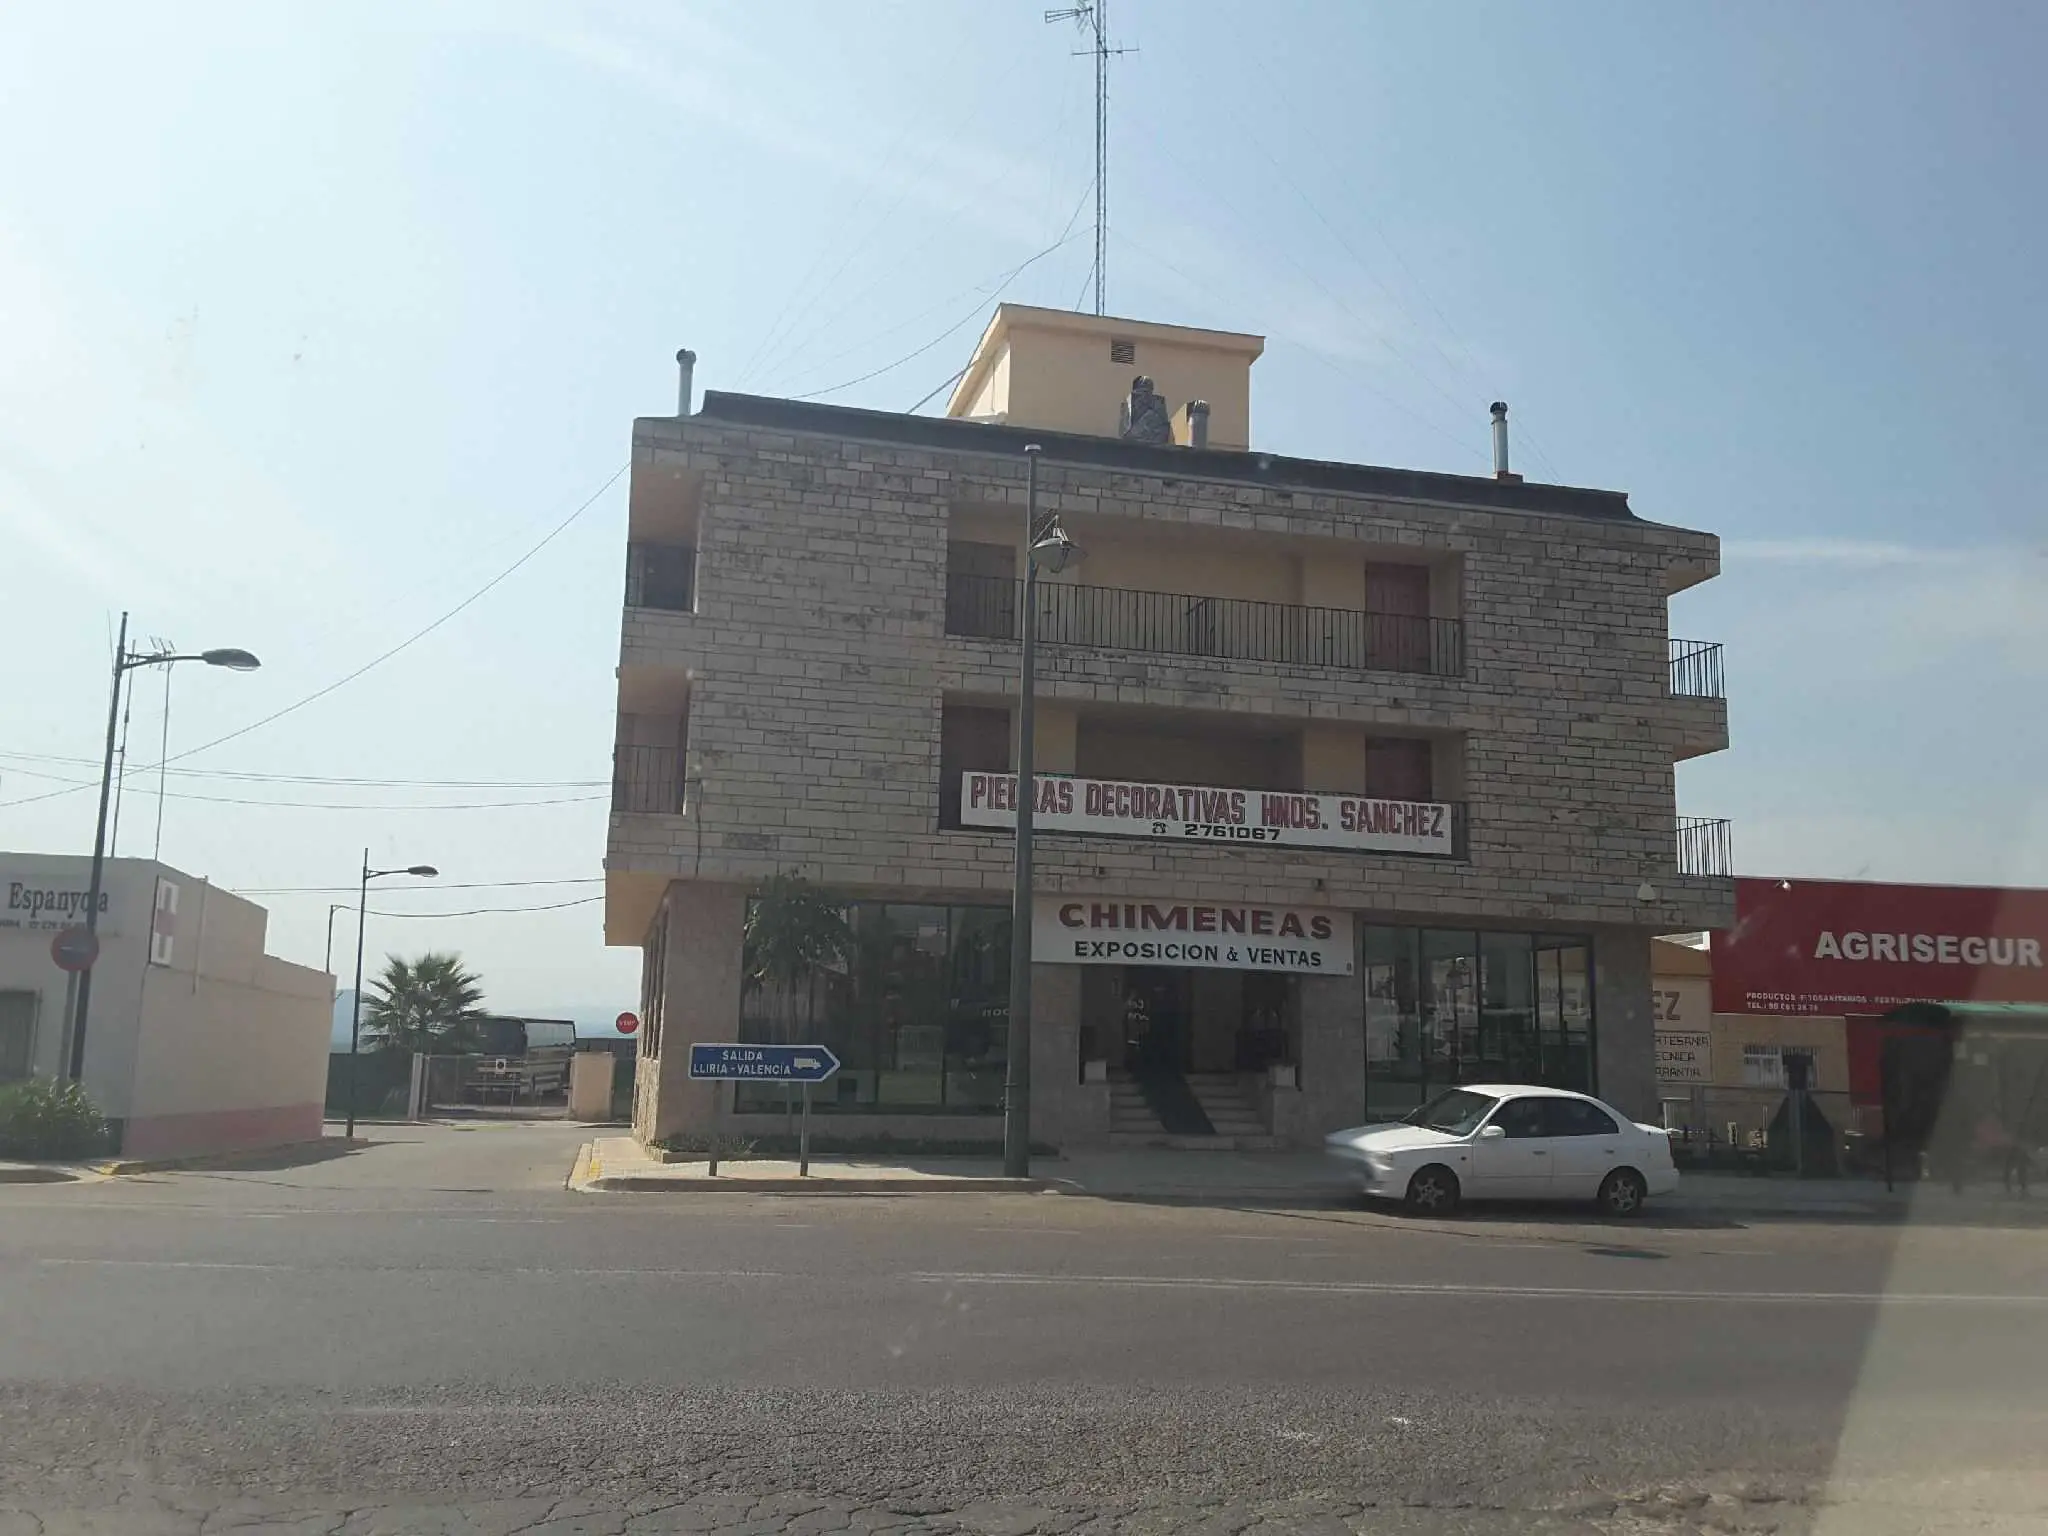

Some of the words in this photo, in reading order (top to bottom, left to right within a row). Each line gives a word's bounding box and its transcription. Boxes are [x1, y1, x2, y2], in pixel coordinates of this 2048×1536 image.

[1085, 782, 1246, 826] DECORATIVAS
[1340, 799, 1444, 838] SANCHEZ
[1184, 822, 1281, 842] 2761067
[8, 882, 109, 918] Espanyoa
[1058, 903, 1333, 940] CHIMENEAS
[1074, 940, 1218, 962] EXPOSICION
[1226, 947, 1239, 962] &
[1248, 947, 1322, 967] VENTAS
[1814, 931, 2043, 967] AGRISEGUR
[722, 1050, 763, 1061] SALIDA
